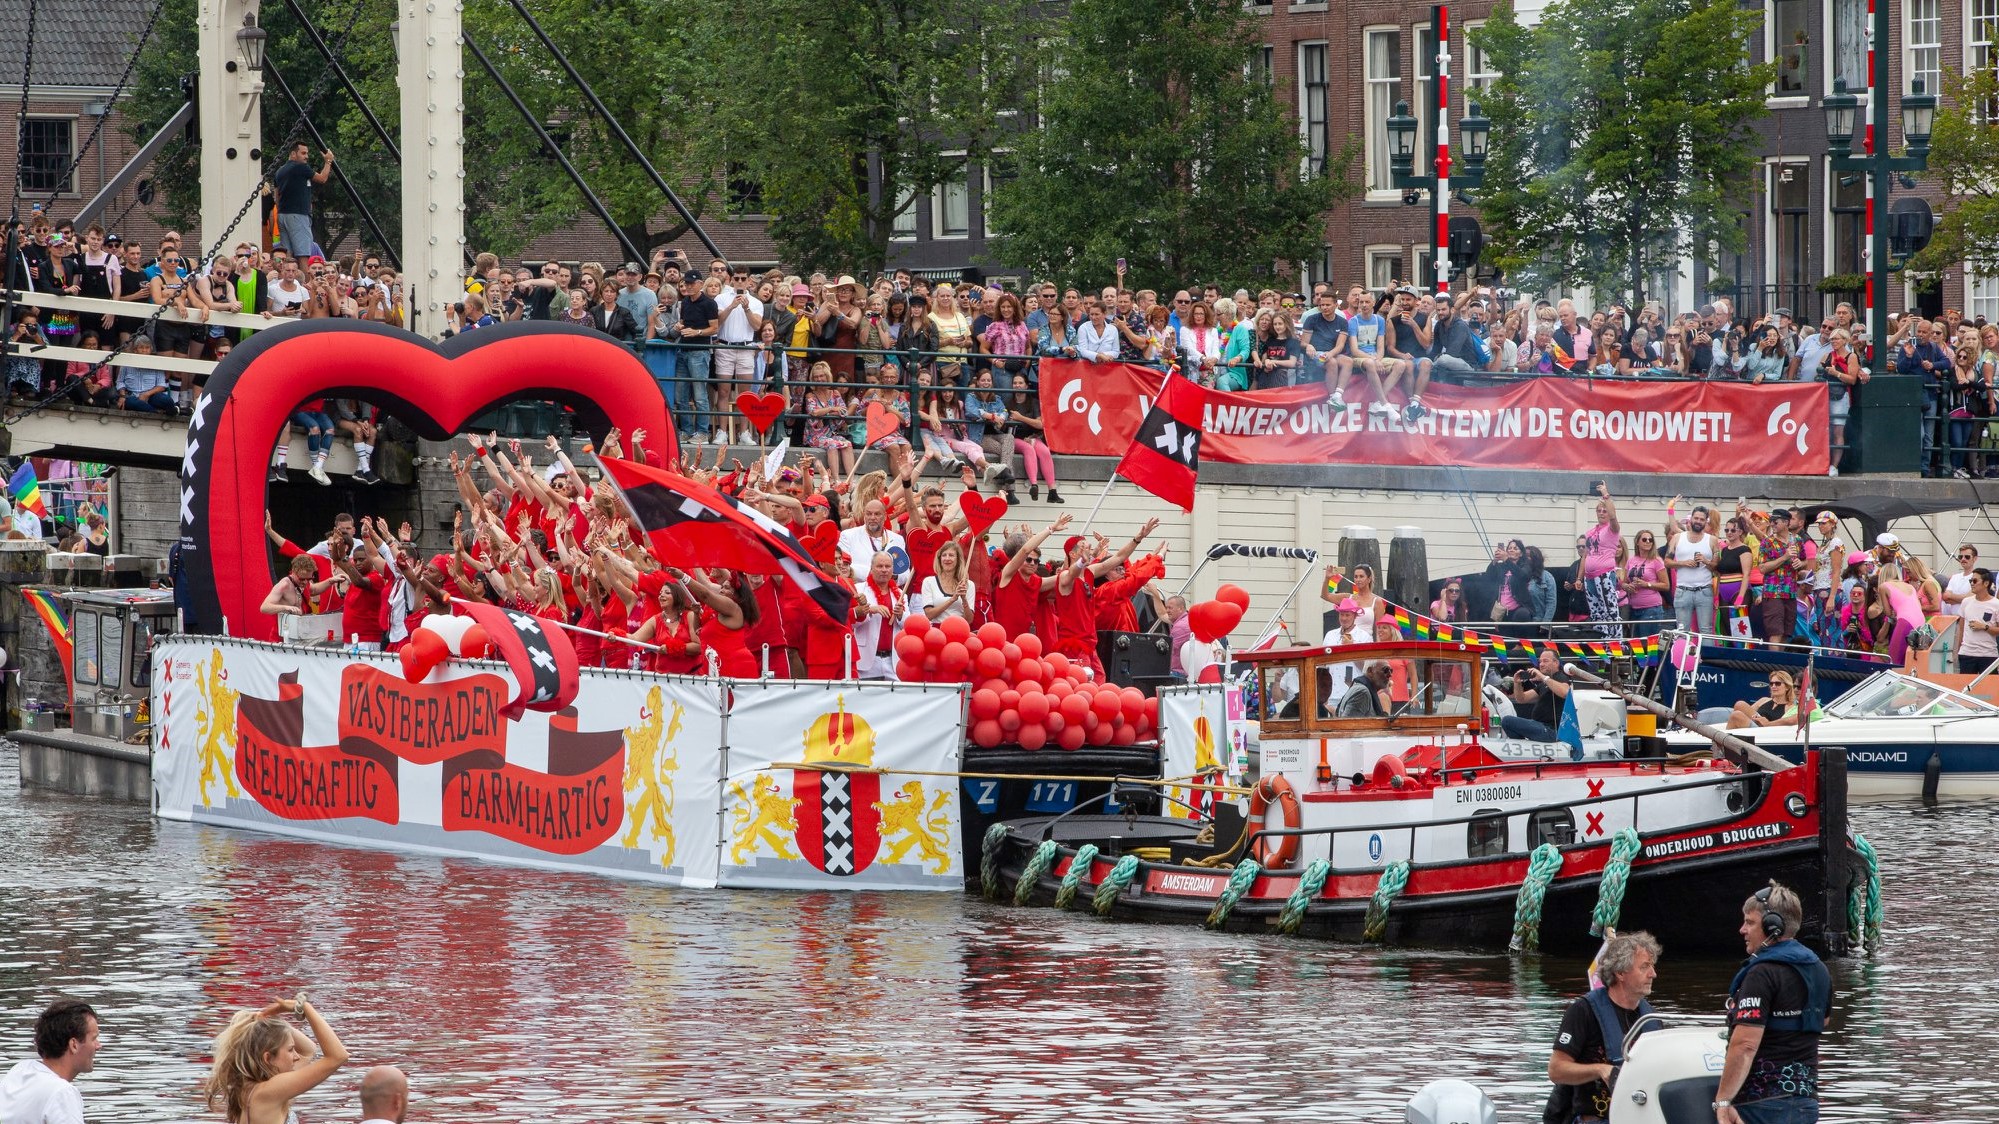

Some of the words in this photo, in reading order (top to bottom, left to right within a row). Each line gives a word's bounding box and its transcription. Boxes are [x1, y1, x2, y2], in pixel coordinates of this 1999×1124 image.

[1139, 394, 1288, 436] VANKER
[1289, 402, 1364, 436] ONZE
[1494, 407, 1523, 438] IN
[1528, 407, 1563, 438] DE
[1569, 408, 1732, 443] GRONDWET!
[1720, 673, 1725, 684] 1
[348, 681, 499, 749] VASTBERADEN
[243, 734, 378, 810] HELDHAFTIG
[977, 781, 998, 805] Z
[1033, 782, 1073, 802] 171
[1456, 789, 1473, 803] ENI
[1475, 784, 1522, 802] 03800804
[460, 770, 610, 840] BARMHARTIG
[1645, 834, 1714, 858] ONDERHOUD
[1722, 823, 1781, 845] BRUGGEN
[1161, 873, 1216, 892] AMSTERDAM
[1738, 996, 1762, 1010] CREW
